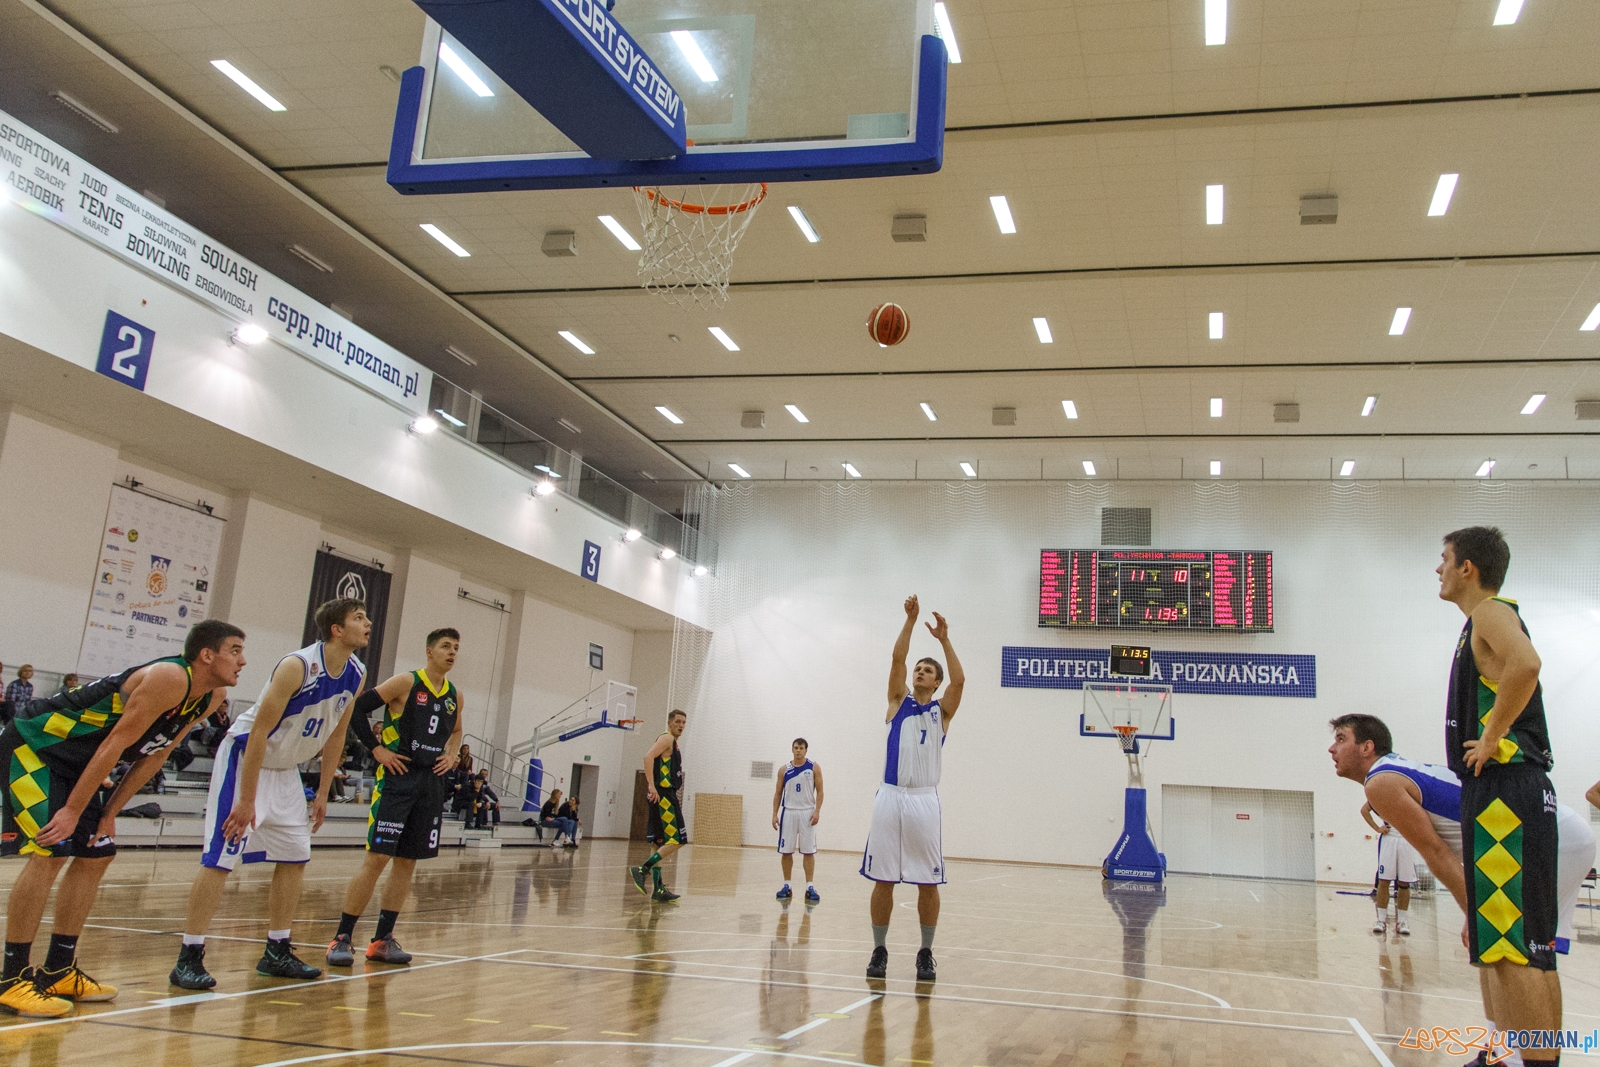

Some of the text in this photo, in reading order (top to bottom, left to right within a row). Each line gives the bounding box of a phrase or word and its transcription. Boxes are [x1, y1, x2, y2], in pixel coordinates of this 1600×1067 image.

[0, 123, 70, 176] SPORTOWA
[34, 166, 66, 190] SZACHY
[80, 172, 108, 197] JUDO
[6, 170, 65, 212] AEROBIK
[78, 190, 124, 230] TENIS
[82, 216, 109, 236] KARATE
[144, 226, 187, 259] SIŁOWNIA
[126, 232, 190, 282] BOWLING
[200, 244, 258, 292] SQUASH
[195, 274, 254, 316] ERGOWIOSŁA
[111, 325, 142, 380] 2
[267, 296, 419, 398] cspp.put.poznan.pl
[586, 546, 598, 576] 3
[1130, 570, 1145, 582] 11
[1174, 570, 1188, 582] 10
[132, 610, 168, 626] PARTNERZY:
[1016, 658, 1300, 685] POLITECHA POZNAŃSKA
[302, 718, 324, 738] 91
[428, 714, 440, 734] 9
[920, 730, 926, 744] 7
[796, 784, 802, 792] 8
[226, 834, 248, 856] 91
[429, 828, 438, 848] 9
[868, 854, 873, 872] 7
[1379, 864, 1384, 874] 9
